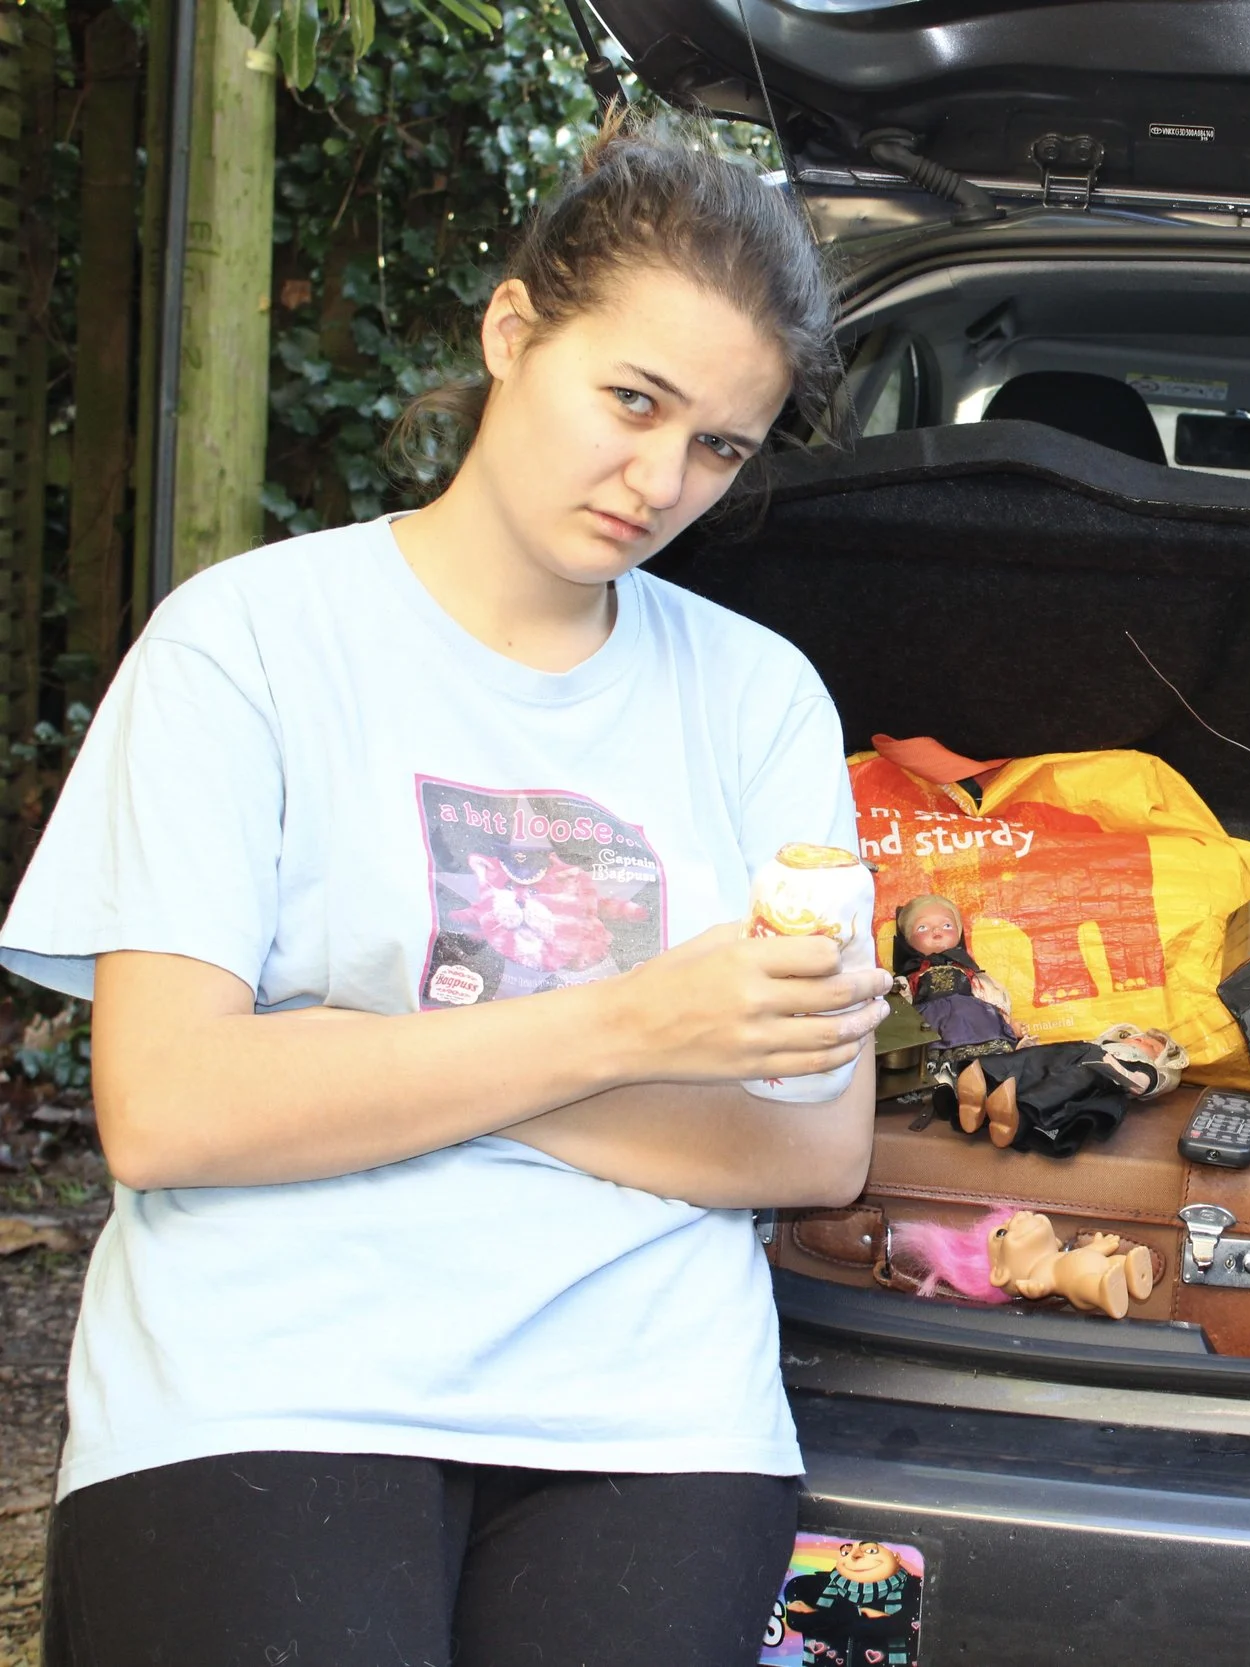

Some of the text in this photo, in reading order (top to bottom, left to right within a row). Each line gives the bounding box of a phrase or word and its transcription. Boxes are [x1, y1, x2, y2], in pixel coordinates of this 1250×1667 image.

[440, 804, 459, 822] a
[463, 801, 507, 835] bit
[860, 821, 1035, 859] nd sturdy
[598, 848, 656, 870] Captain
[592, 863, 657, 882] Bagpuss
[435, 973, 479, 992] Bagpuss
[1033, 1016, 1074, 1032] material
